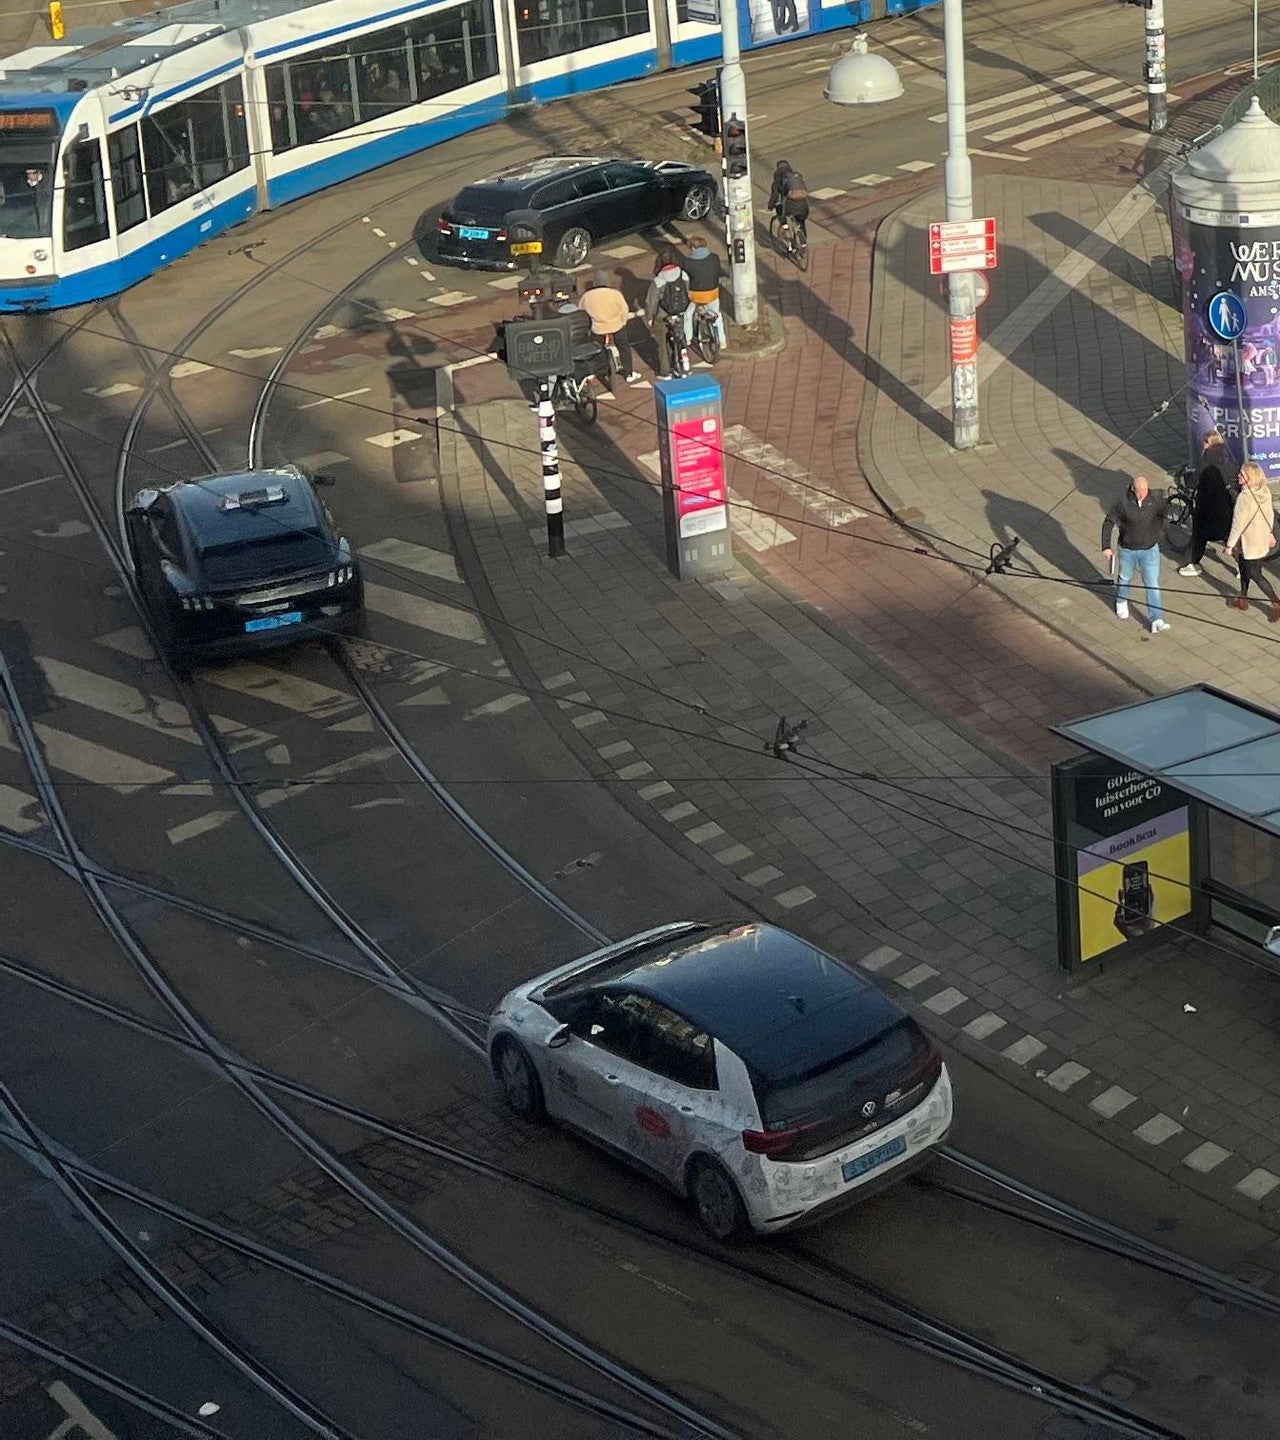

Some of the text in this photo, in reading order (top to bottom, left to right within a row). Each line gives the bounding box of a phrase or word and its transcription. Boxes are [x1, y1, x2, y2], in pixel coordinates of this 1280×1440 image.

[1213, 421, 1280, 440] CRUSH
[1107, 774, 1123, 791] 60
[1103, 804, 1119, 818] nu
[1120, 794, 1144, 811] voor
[1109, 827, 1158, 854] BookBeat
